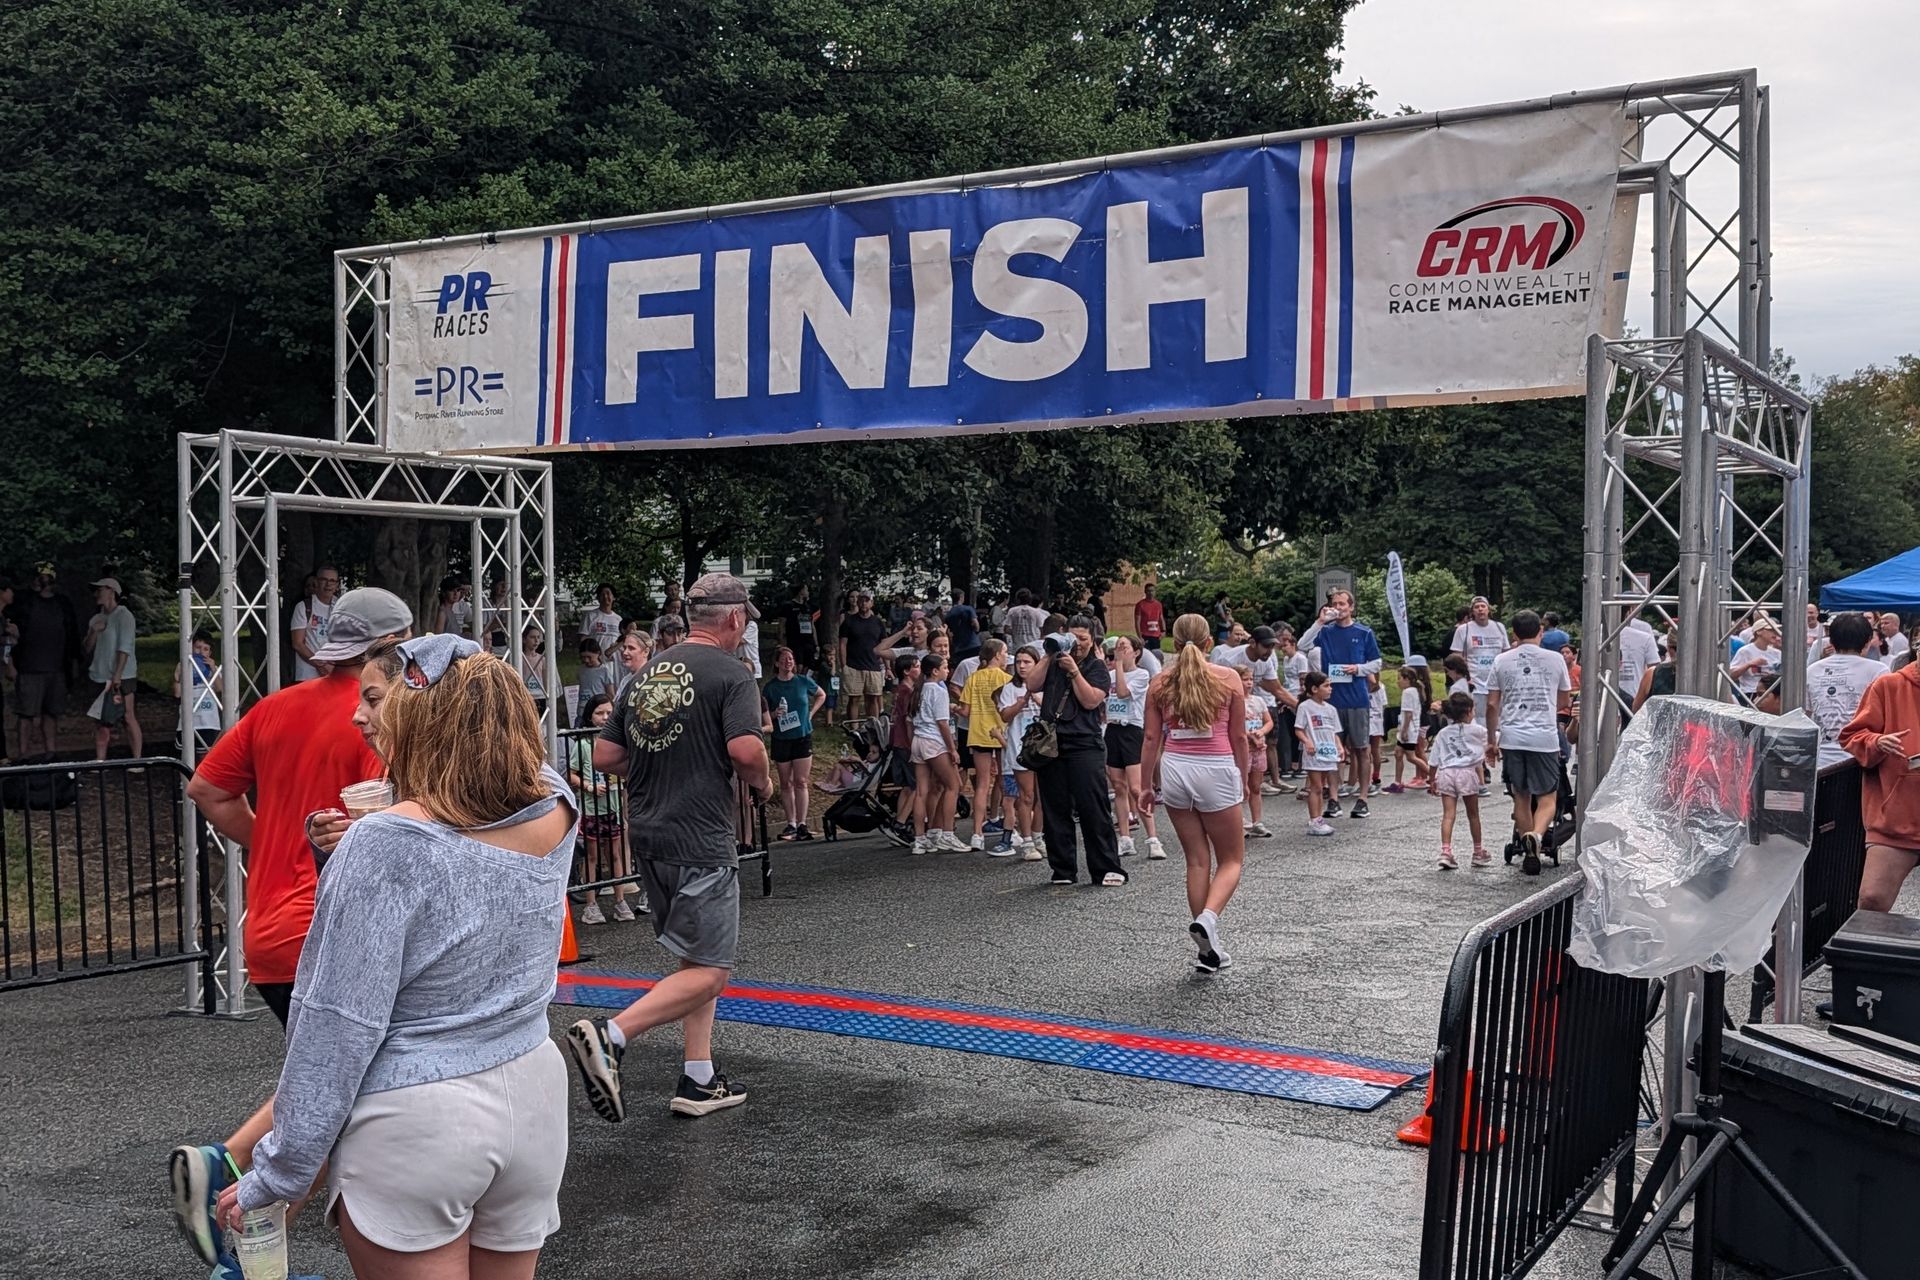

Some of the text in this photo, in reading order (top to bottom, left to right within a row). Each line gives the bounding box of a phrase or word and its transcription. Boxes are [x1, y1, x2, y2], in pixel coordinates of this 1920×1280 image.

[1416, 222, 1558, 277] CRM
[437, 271, 492, 314] PR
[605, 187, 1249, 405] FINISH
[1389, 271, 1591, 298] COMMONWEALTH
[1389, 288, 1591, 314] RACE MANAGEMENT
[433, 312, 489, 338] RACES
[628, 722, 684, 753] NEW MEXICO
